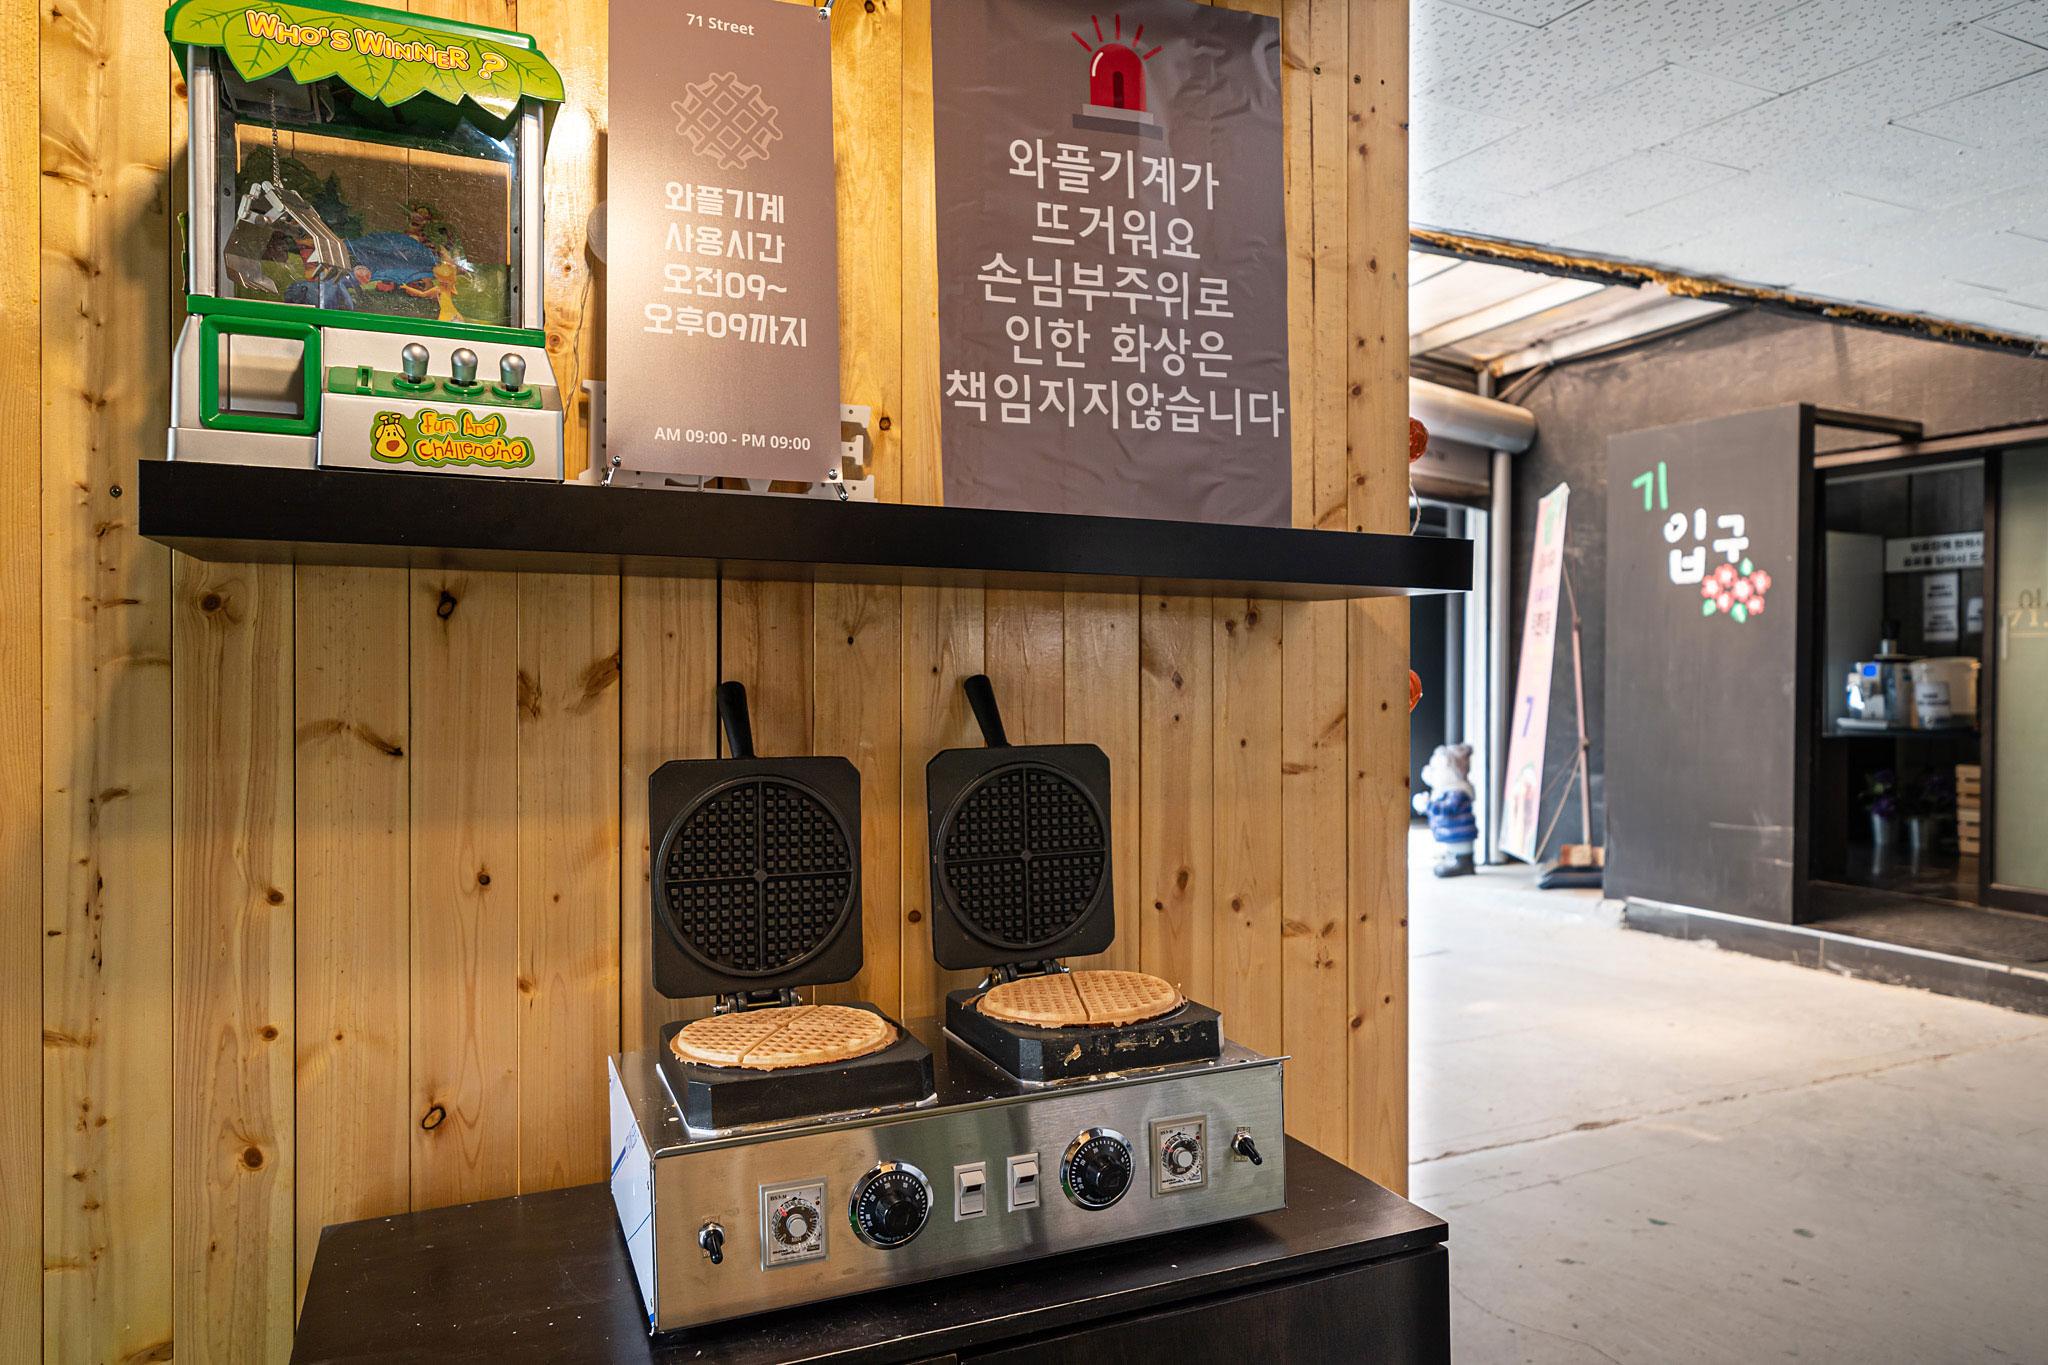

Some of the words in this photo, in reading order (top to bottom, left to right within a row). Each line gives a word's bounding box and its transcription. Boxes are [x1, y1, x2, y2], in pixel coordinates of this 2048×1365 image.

[686, 13, 703, 27] 71
[708, 17, 755, 36] Street
[478, 52, 508, 80] ?
[1009, 138, 1220, 210] 와플기계가
[664, 181, 785, 224] 와플기계
[664, 222, 786, 264] 사용시간
[1032, 202, 1200, 260] 뜨거워요
[663, 263, 787, 301] 오전09~
[977, 252, 1234, 320] 손님부주위로
[643, 303, 807, 347] 오후09까지
[1005, 315, 1091, 368] 인한
[1111, 323, 1233, 378] 화상은
[424, 413, 457, 434] Fun
[464, 412, 496, 435] And
[945, 369, 1285, 438] 책임지지않습니다
[654, 426, 681, 441] AM
[685, 429, 728, 445] 09:00
[741, 433, 766, 447] PM
[770, 435, 811, 450] 09:00
[1663, 507, 1749, 585] 입구
